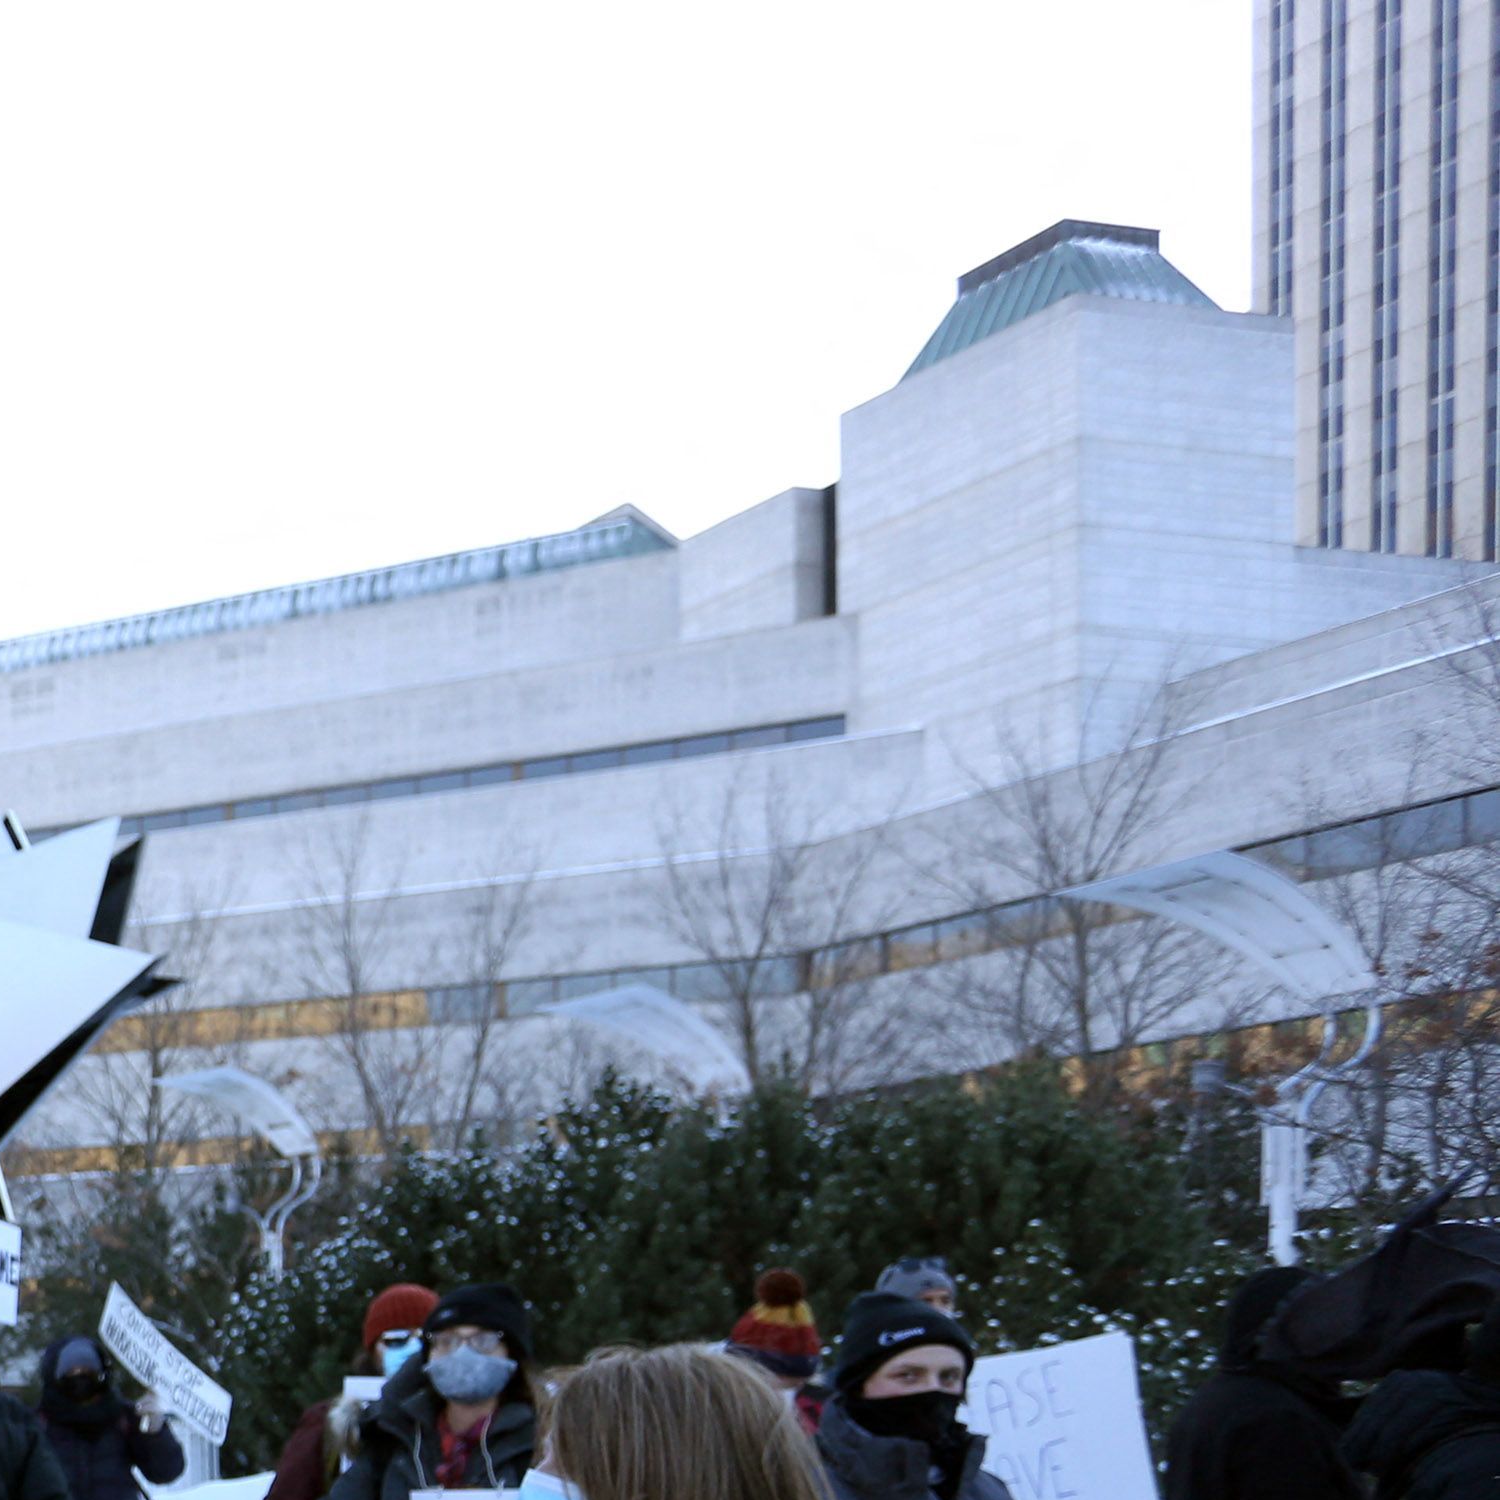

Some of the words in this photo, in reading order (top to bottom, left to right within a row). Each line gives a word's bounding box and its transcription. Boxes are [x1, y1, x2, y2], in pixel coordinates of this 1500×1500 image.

[166, 1351, 205, 1389] STOP
[974, 1359, 1077, 1431] ASE
[994, 1436, 1079, 1500] AVE
